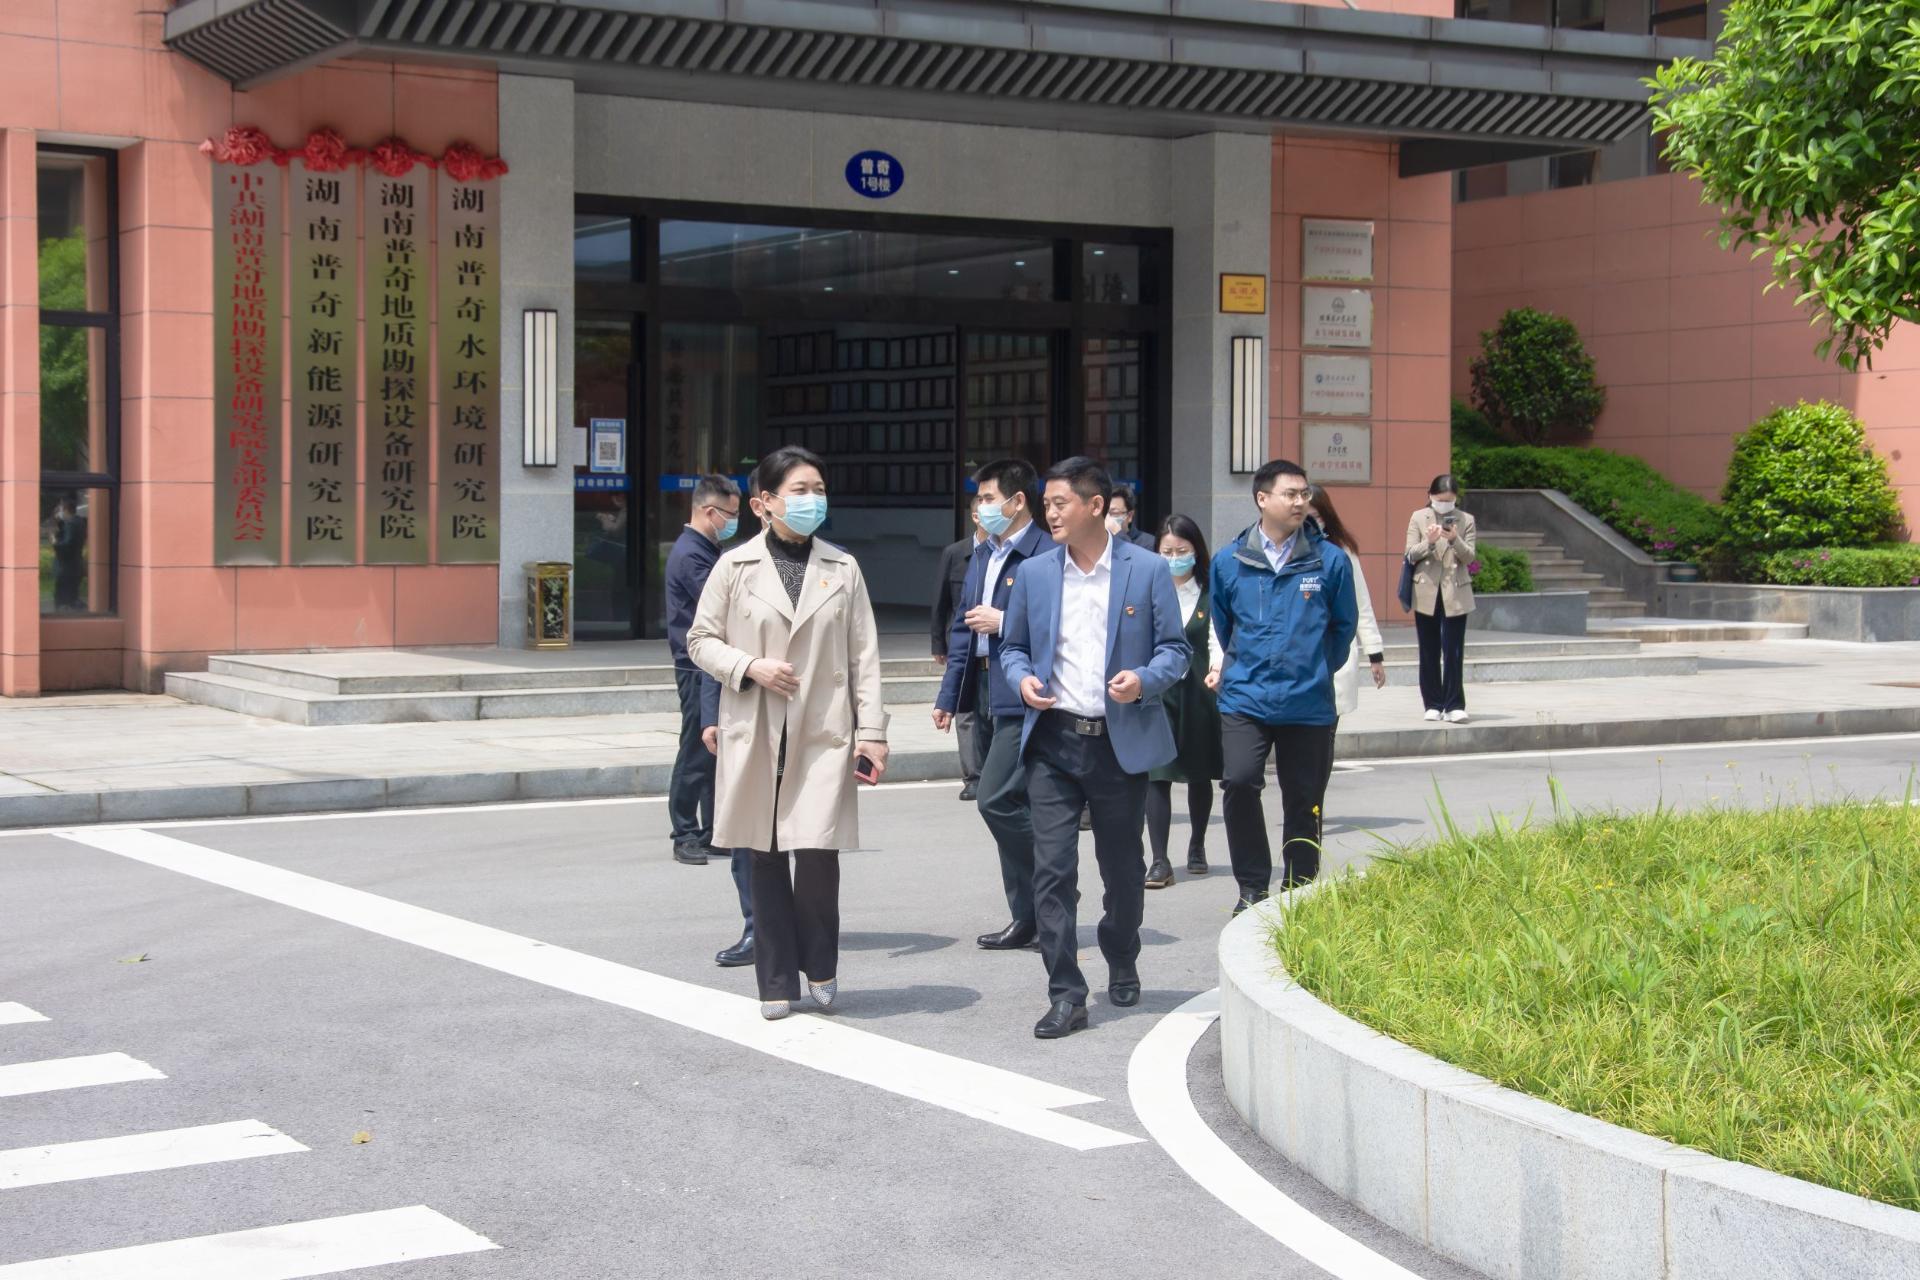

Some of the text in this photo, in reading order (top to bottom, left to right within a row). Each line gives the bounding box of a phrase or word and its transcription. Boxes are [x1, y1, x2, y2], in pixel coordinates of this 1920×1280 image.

[306, 178, 343, 541] 湖南普奇新能源研究院
[380, 183, 416, 540] 湖南普奇地质勘探设备研究院
[452, 188, 487, 539] 湖南普奇水环境研究院
